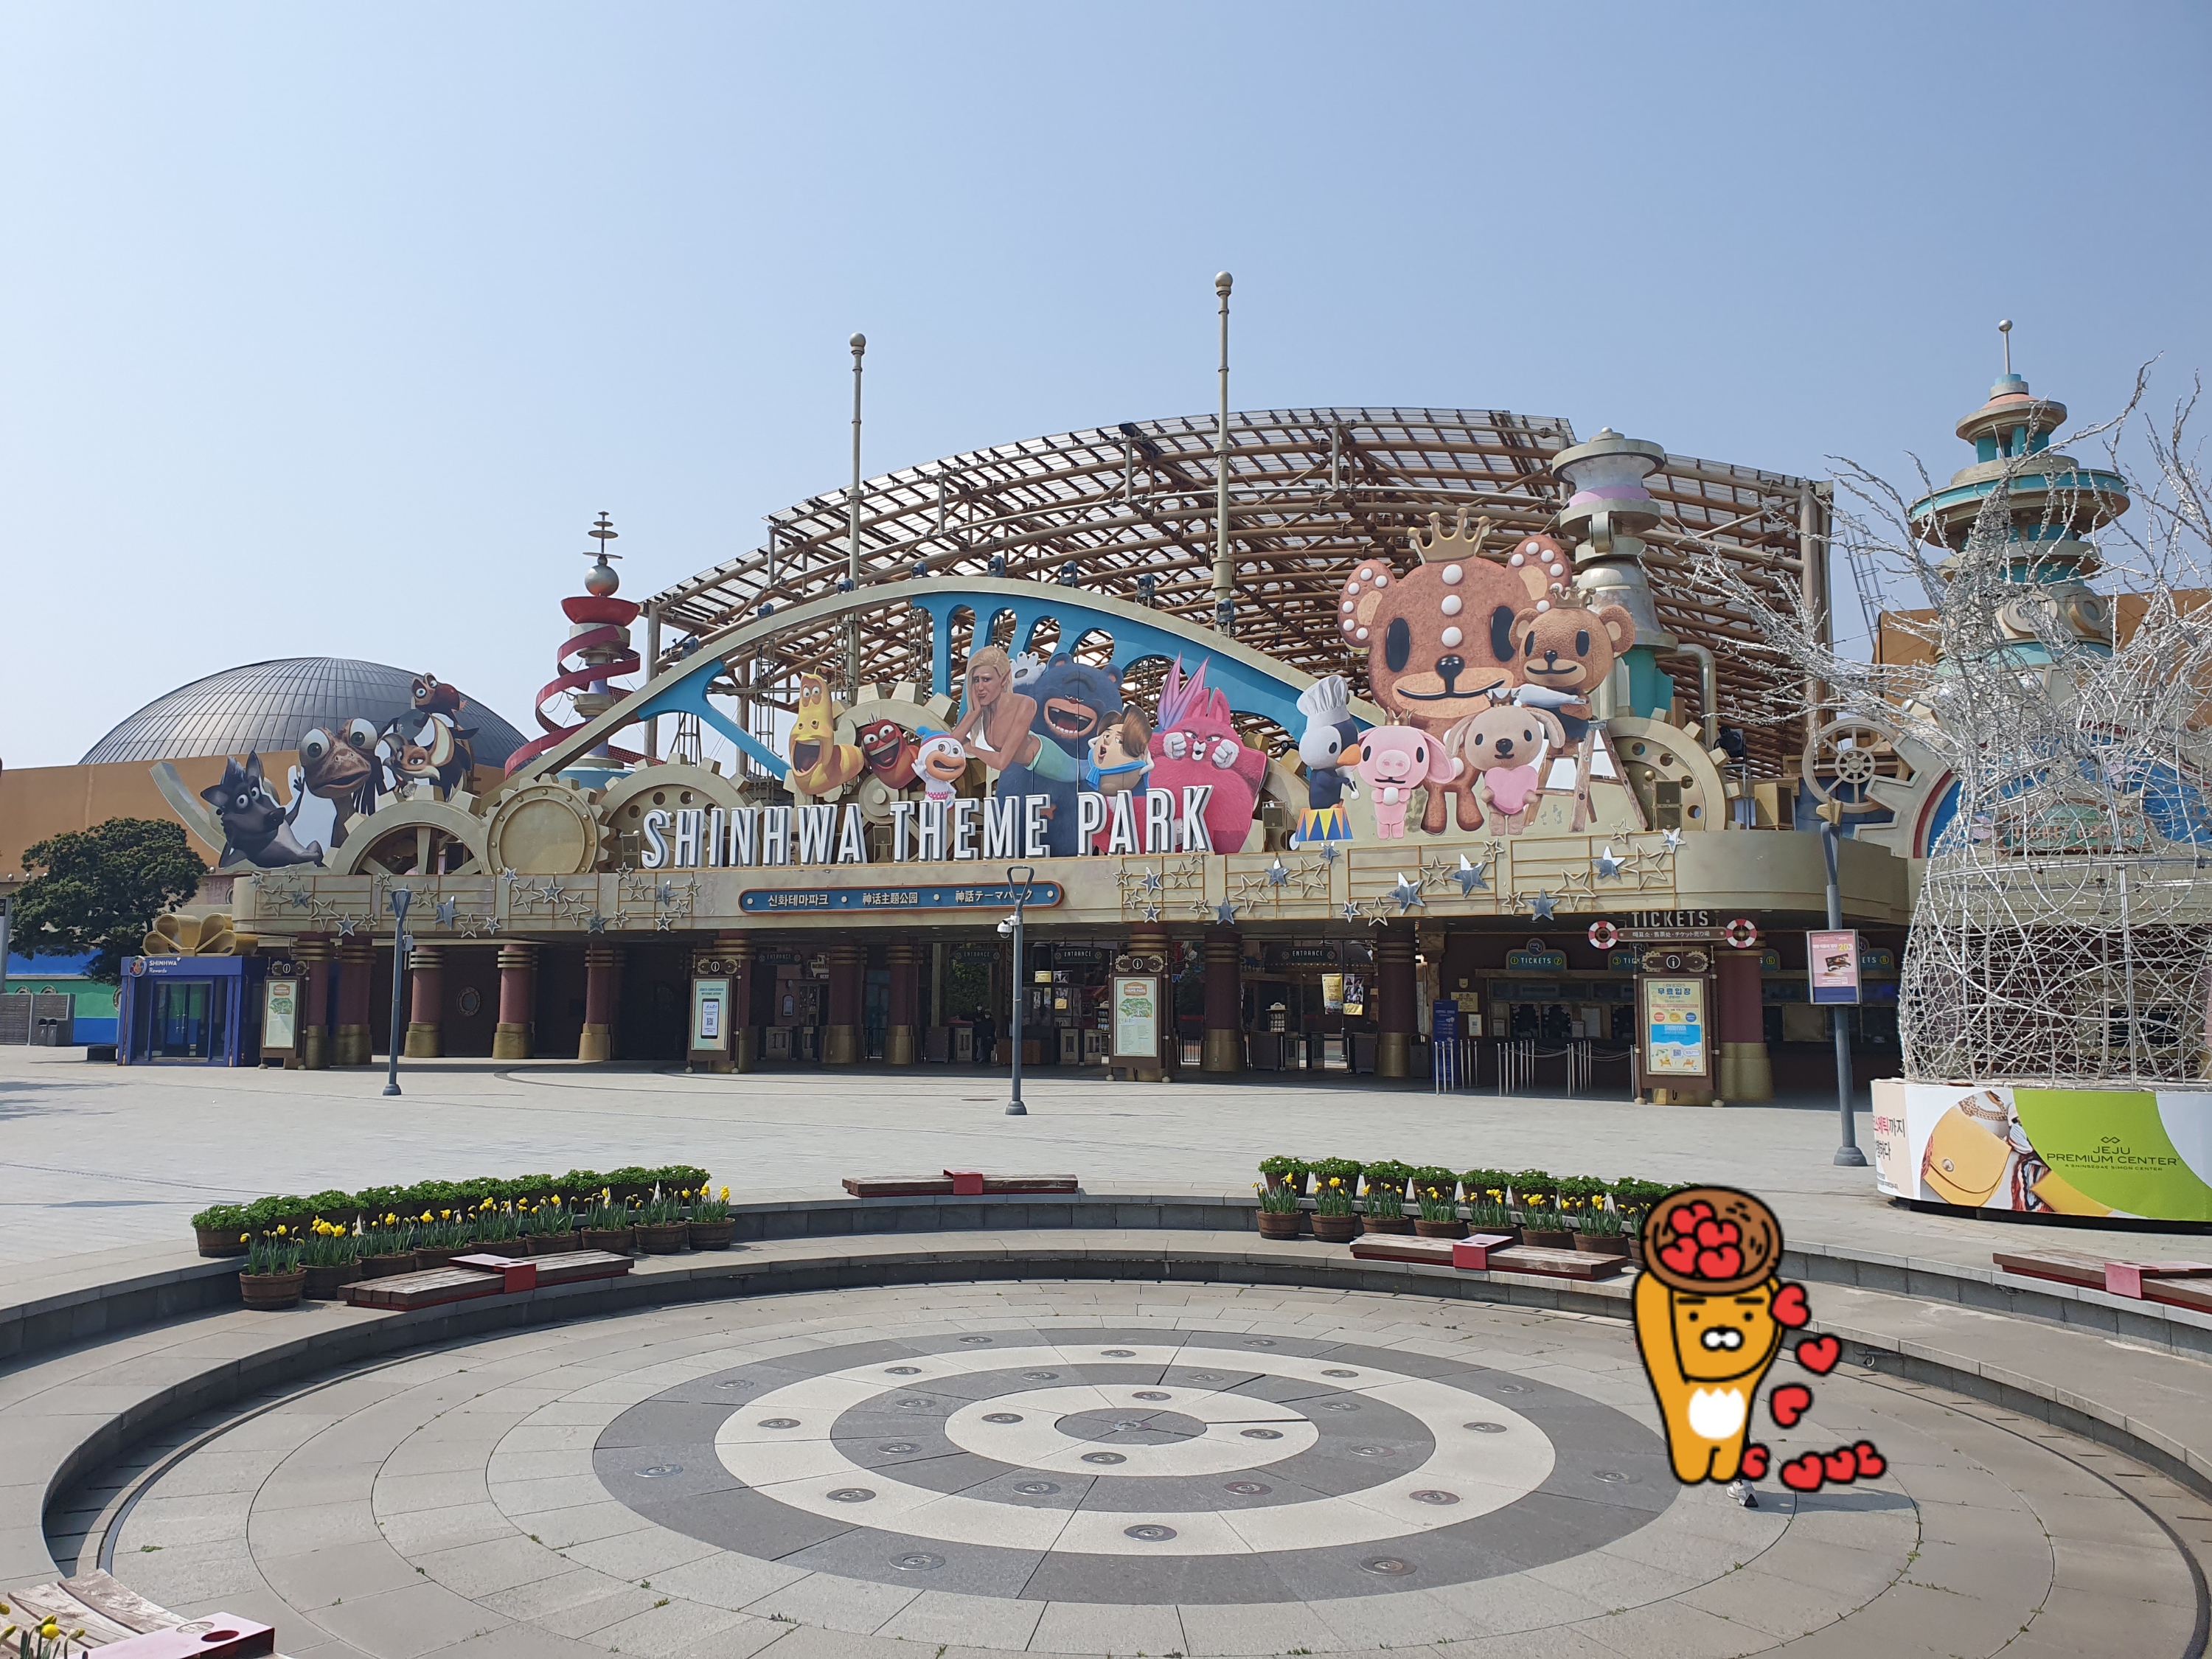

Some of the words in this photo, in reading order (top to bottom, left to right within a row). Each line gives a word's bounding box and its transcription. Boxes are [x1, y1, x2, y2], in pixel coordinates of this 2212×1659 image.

[641, 803, 868, 869] SHINHWA
[889, 794, 1051, 863] THEME
[1077, 785, 1214, 858] PARK
[2014, 824, 2069, 840] TCKET
[768, 894, 829, 907] 신화테마파크
[862, 891, 918, 905] 神话主题公园
[1631, 911, 1708, 928] TICKETS
[1873, 1115, 1905, 1138] 스메틱까지
[2093, 1146, 2130, 1155] JEJU
[2046, 1153, 2113, 1164] PREMIUM
[2118, 1156, 2177, 1166] CENTER
